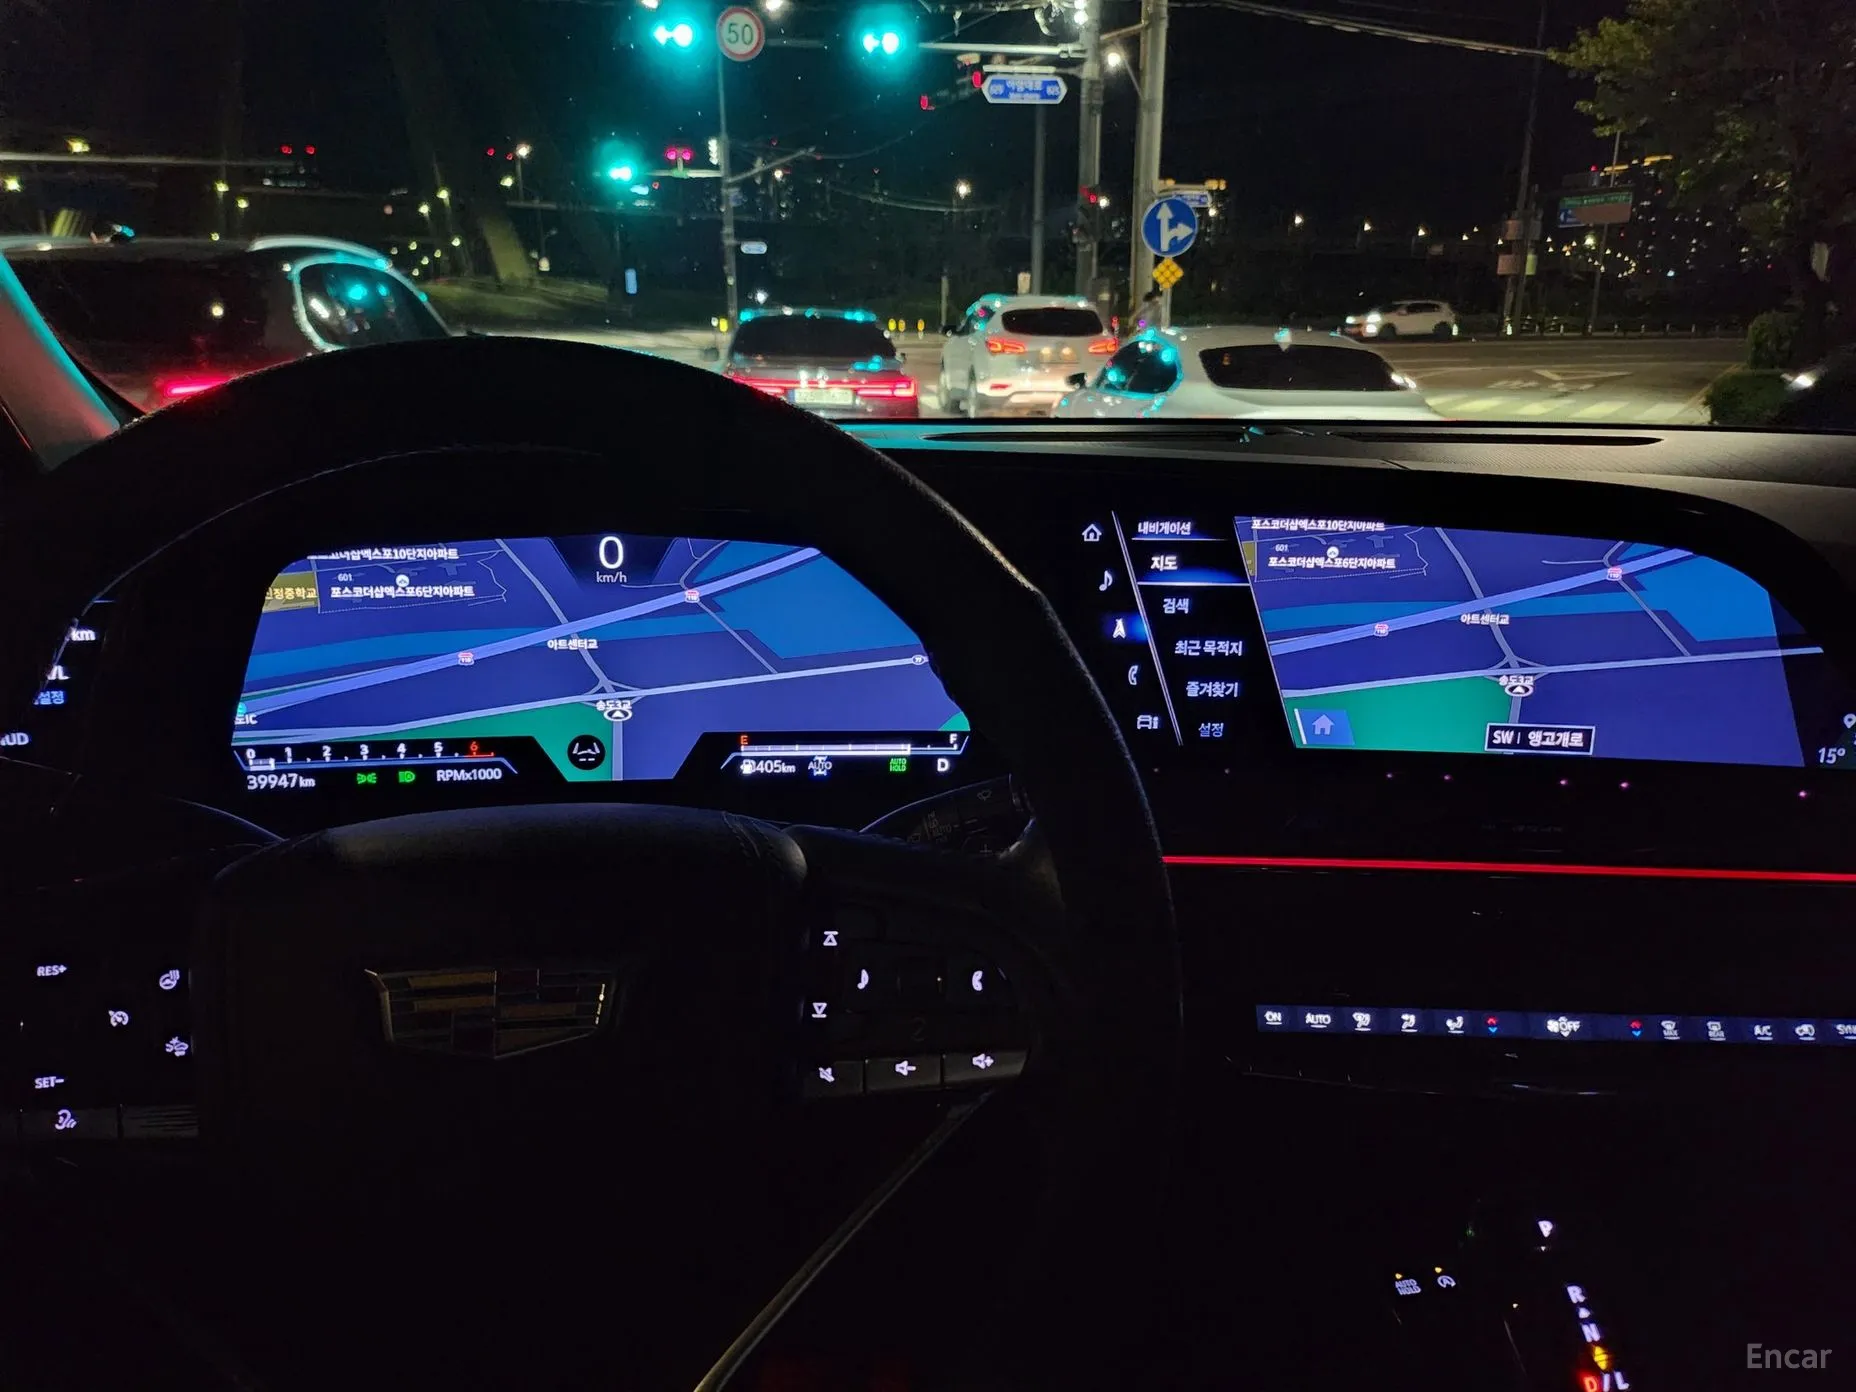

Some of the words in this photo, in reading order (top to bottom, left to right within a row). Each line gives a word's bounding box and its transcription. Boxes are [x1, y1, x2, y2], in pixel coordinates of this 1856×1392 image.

[727, 22, 754, 46] 50
[1138, 521, 1191, 535] 내비게이션
[598, 536, 624, 569] 0
[1150, 555, 1178, 572] 지도
[596, 571, 627, 583] km/h
[1162, 598, 1190, 614] 검색
[1460, 613, 1510, 625] 아트센터교
[547, 639, 598, 650] 아트센터교
[1174, 640, 1201, 656] 최근
[1203, 640, 1243, 657] 목적지
[1499, 675, 1534, 686] 송도3교
[1186, 681, 1239, 697] 즐겨찾기
[596, 700, 632, 711] 송도3교
[1198, 722, 1224, 737] 설정
[740, 736, 748, 744] E
[950, 734, 957, 744] F
[1492, 730, 1514, 744] SW
[1528, 731, 1584, 747] 앵고개로
[246, 748, 256, 759] 0
[284, 746, 292, 757] 1
[322, 746, 331, 757] 2
[360, 744, 369, 755] 3
[397, 743, 406, 754] 4
[434, 742, 443, 752] 5
[470, 742, 478, 750] 6
[937, 759, 949, 771] D
[436, 768, 502, 782] RPMx1000
[1264, 1011, 1282, 1021] ON
[1305, 1012, 1331, 1025] AUTO
[1754, 1024, 1772, 1036] A/C
[1538, 1220, 1553, 1237] P
[1567, 1286, 1585, 1303] R
[1581, 1323, 1600, 1342] N
